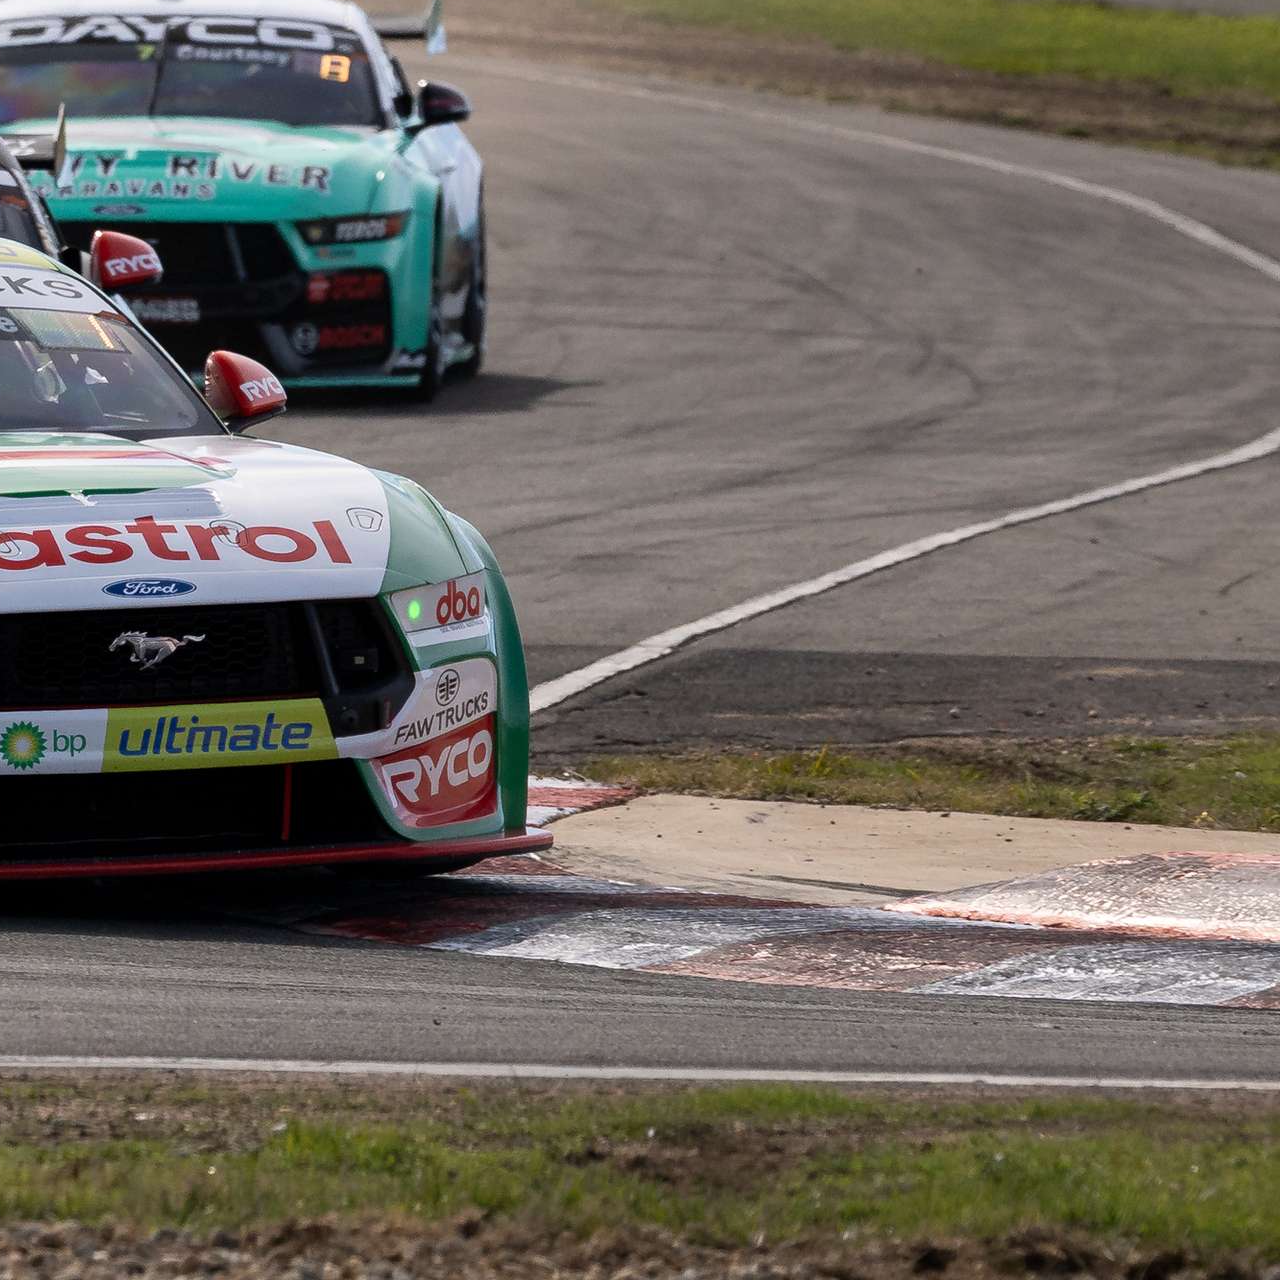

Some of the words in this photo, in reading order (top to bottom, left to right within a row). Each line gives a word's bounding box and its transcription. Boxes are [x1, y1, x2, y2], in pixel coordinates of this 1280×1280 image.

[319, 54, 352, 83] 8
[168, 155, 330, 194] RIVER
[123, 578, 179, 596] Ford
[436, 580, 480, 625] dba
[119, 712, 313, 757] ultimate
[394, 713, 436, 746] FAW
[433, 691, 489, 731] TRUCKS
[52, 729, 87, 757] bp
[382, 729, 493, 808] RYCO
